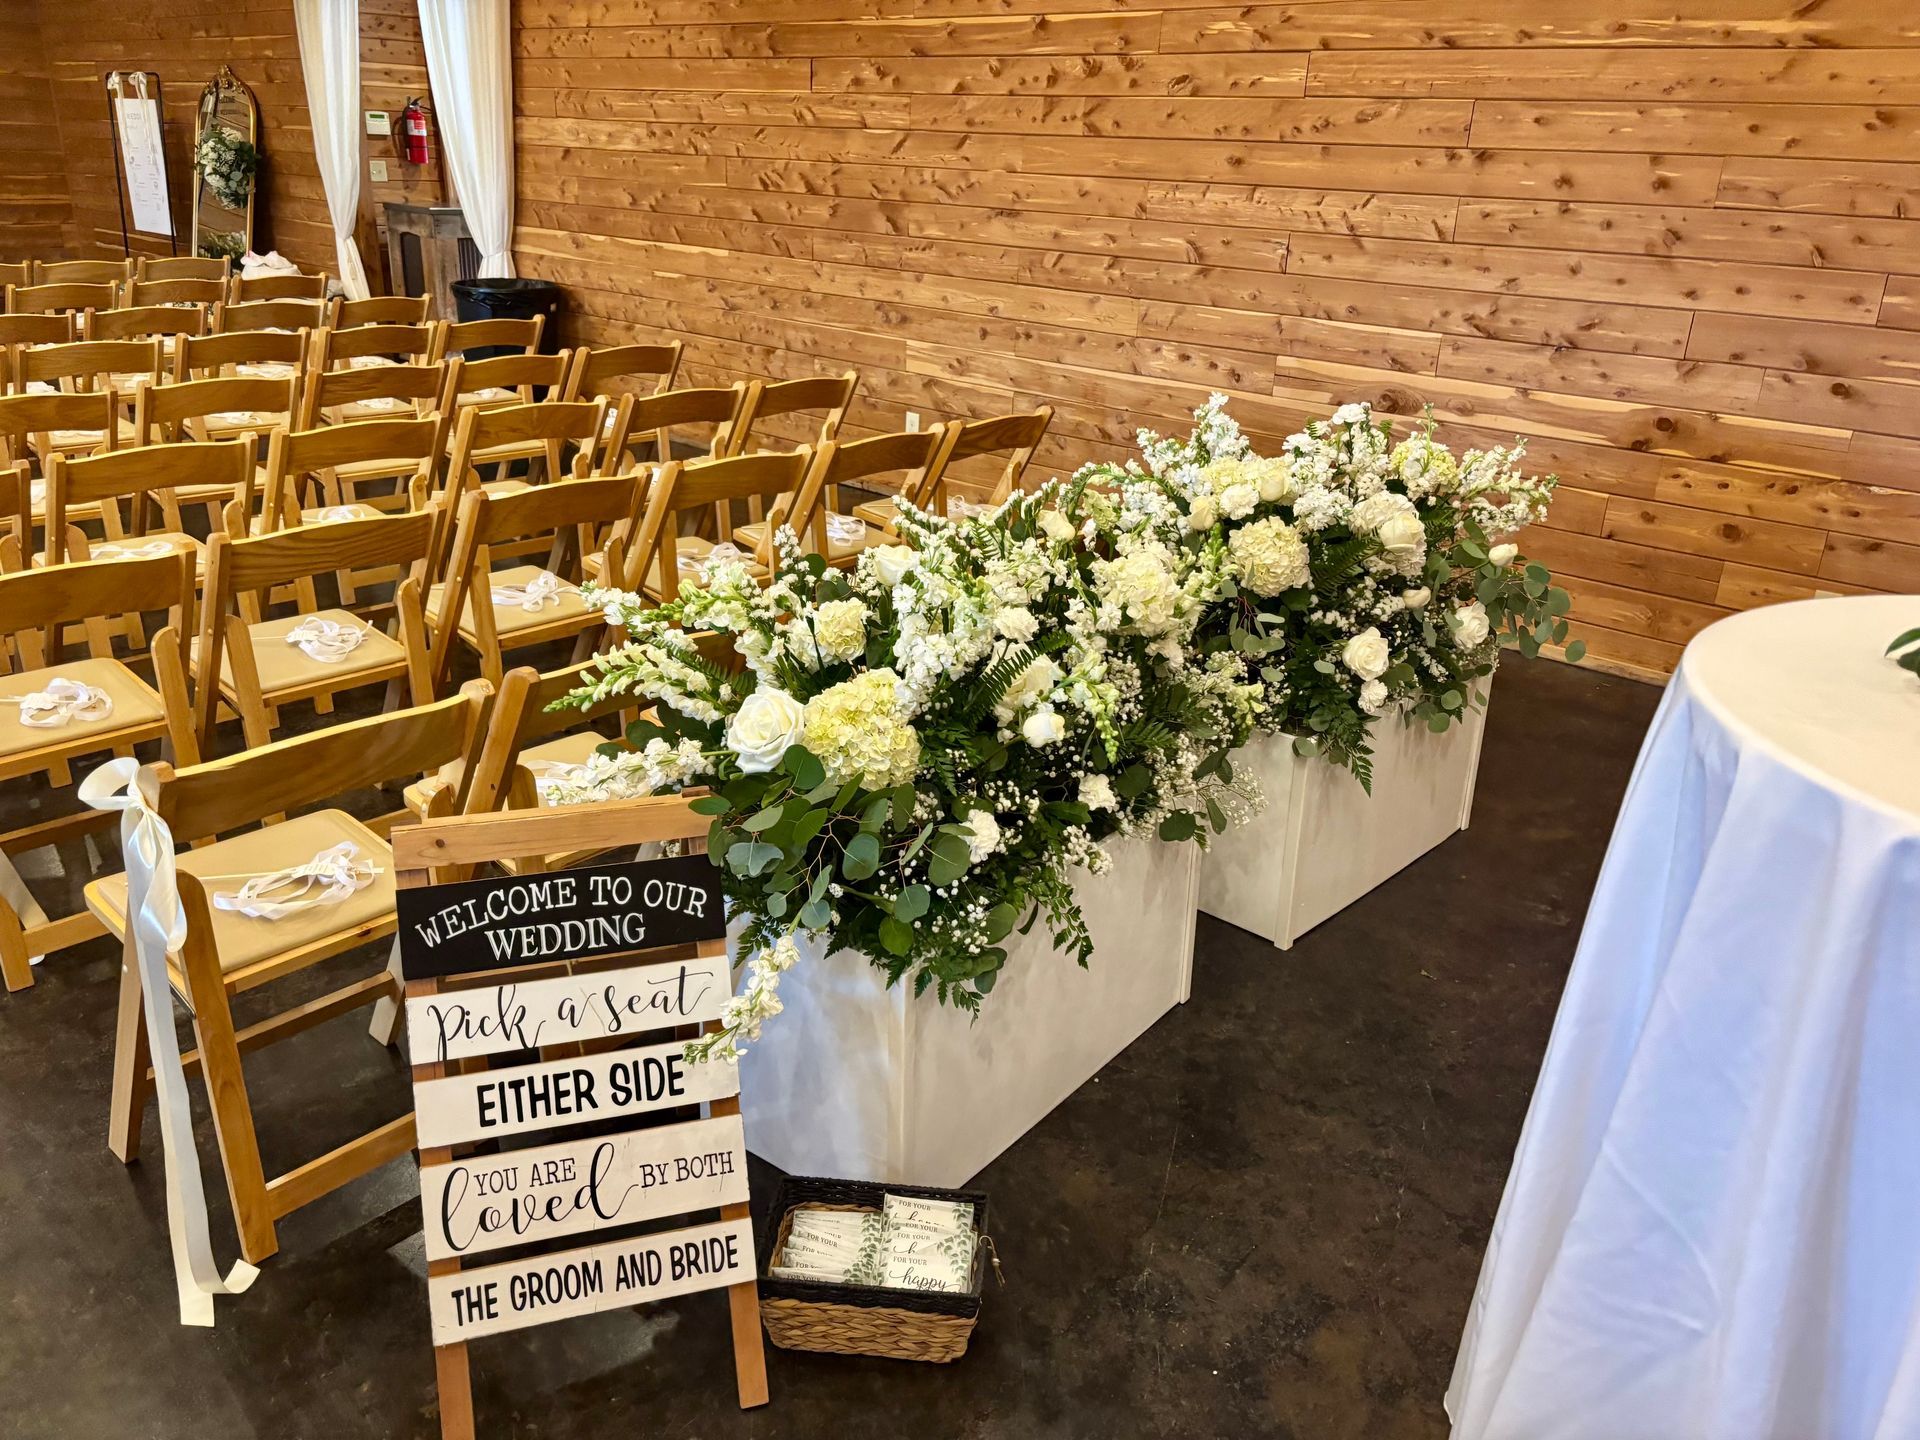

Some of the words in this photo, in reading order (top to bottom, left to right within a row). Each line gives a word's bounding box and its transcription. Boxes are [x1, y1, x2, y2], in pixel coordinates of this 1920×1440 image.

[414, 877, 577, 949] WELCOME
[589, 876, 632, 906] TO
[643, 879, 708, 919] OUR
[484, 912, 647, 961] WEDDING
[556, 992, 597, 1028] a
[603, 965, 714, 1033] seat
[476, 1069, 599, 1128] EITHER
[609, 1053, 686, 1107] SIDE
[473, 1167, 519, 1197] YOU
[529, 1157, 577, 1188] ARE
[639, 1162, 669, 1189] BY
[674, 1150, 736, 1183] BOTH
[441, 1141, 640, 1252] loved
[898, 1199, 912, 1208] FOR
[912, 1202, 932, 1212] YOUR
[807, 1232, 820, 1243] FOR
[820, 1237, 839, 1248] YOUR
[897, 1232, 912, 1240] FOR
[919, 1223, 938, 1233] YOUR
[451, 1281, 499, 1328] THE
[509, 1259, 604, 1312] GROOM
[615, 1249, 662, 1292] AND
[670, 1233, 740, 1282] BRIDE
[888, 1266, 962, 1292] happy
[893, 1256, 907, 1264] FOR
[907, 1257, 928, 1266] YOUR
